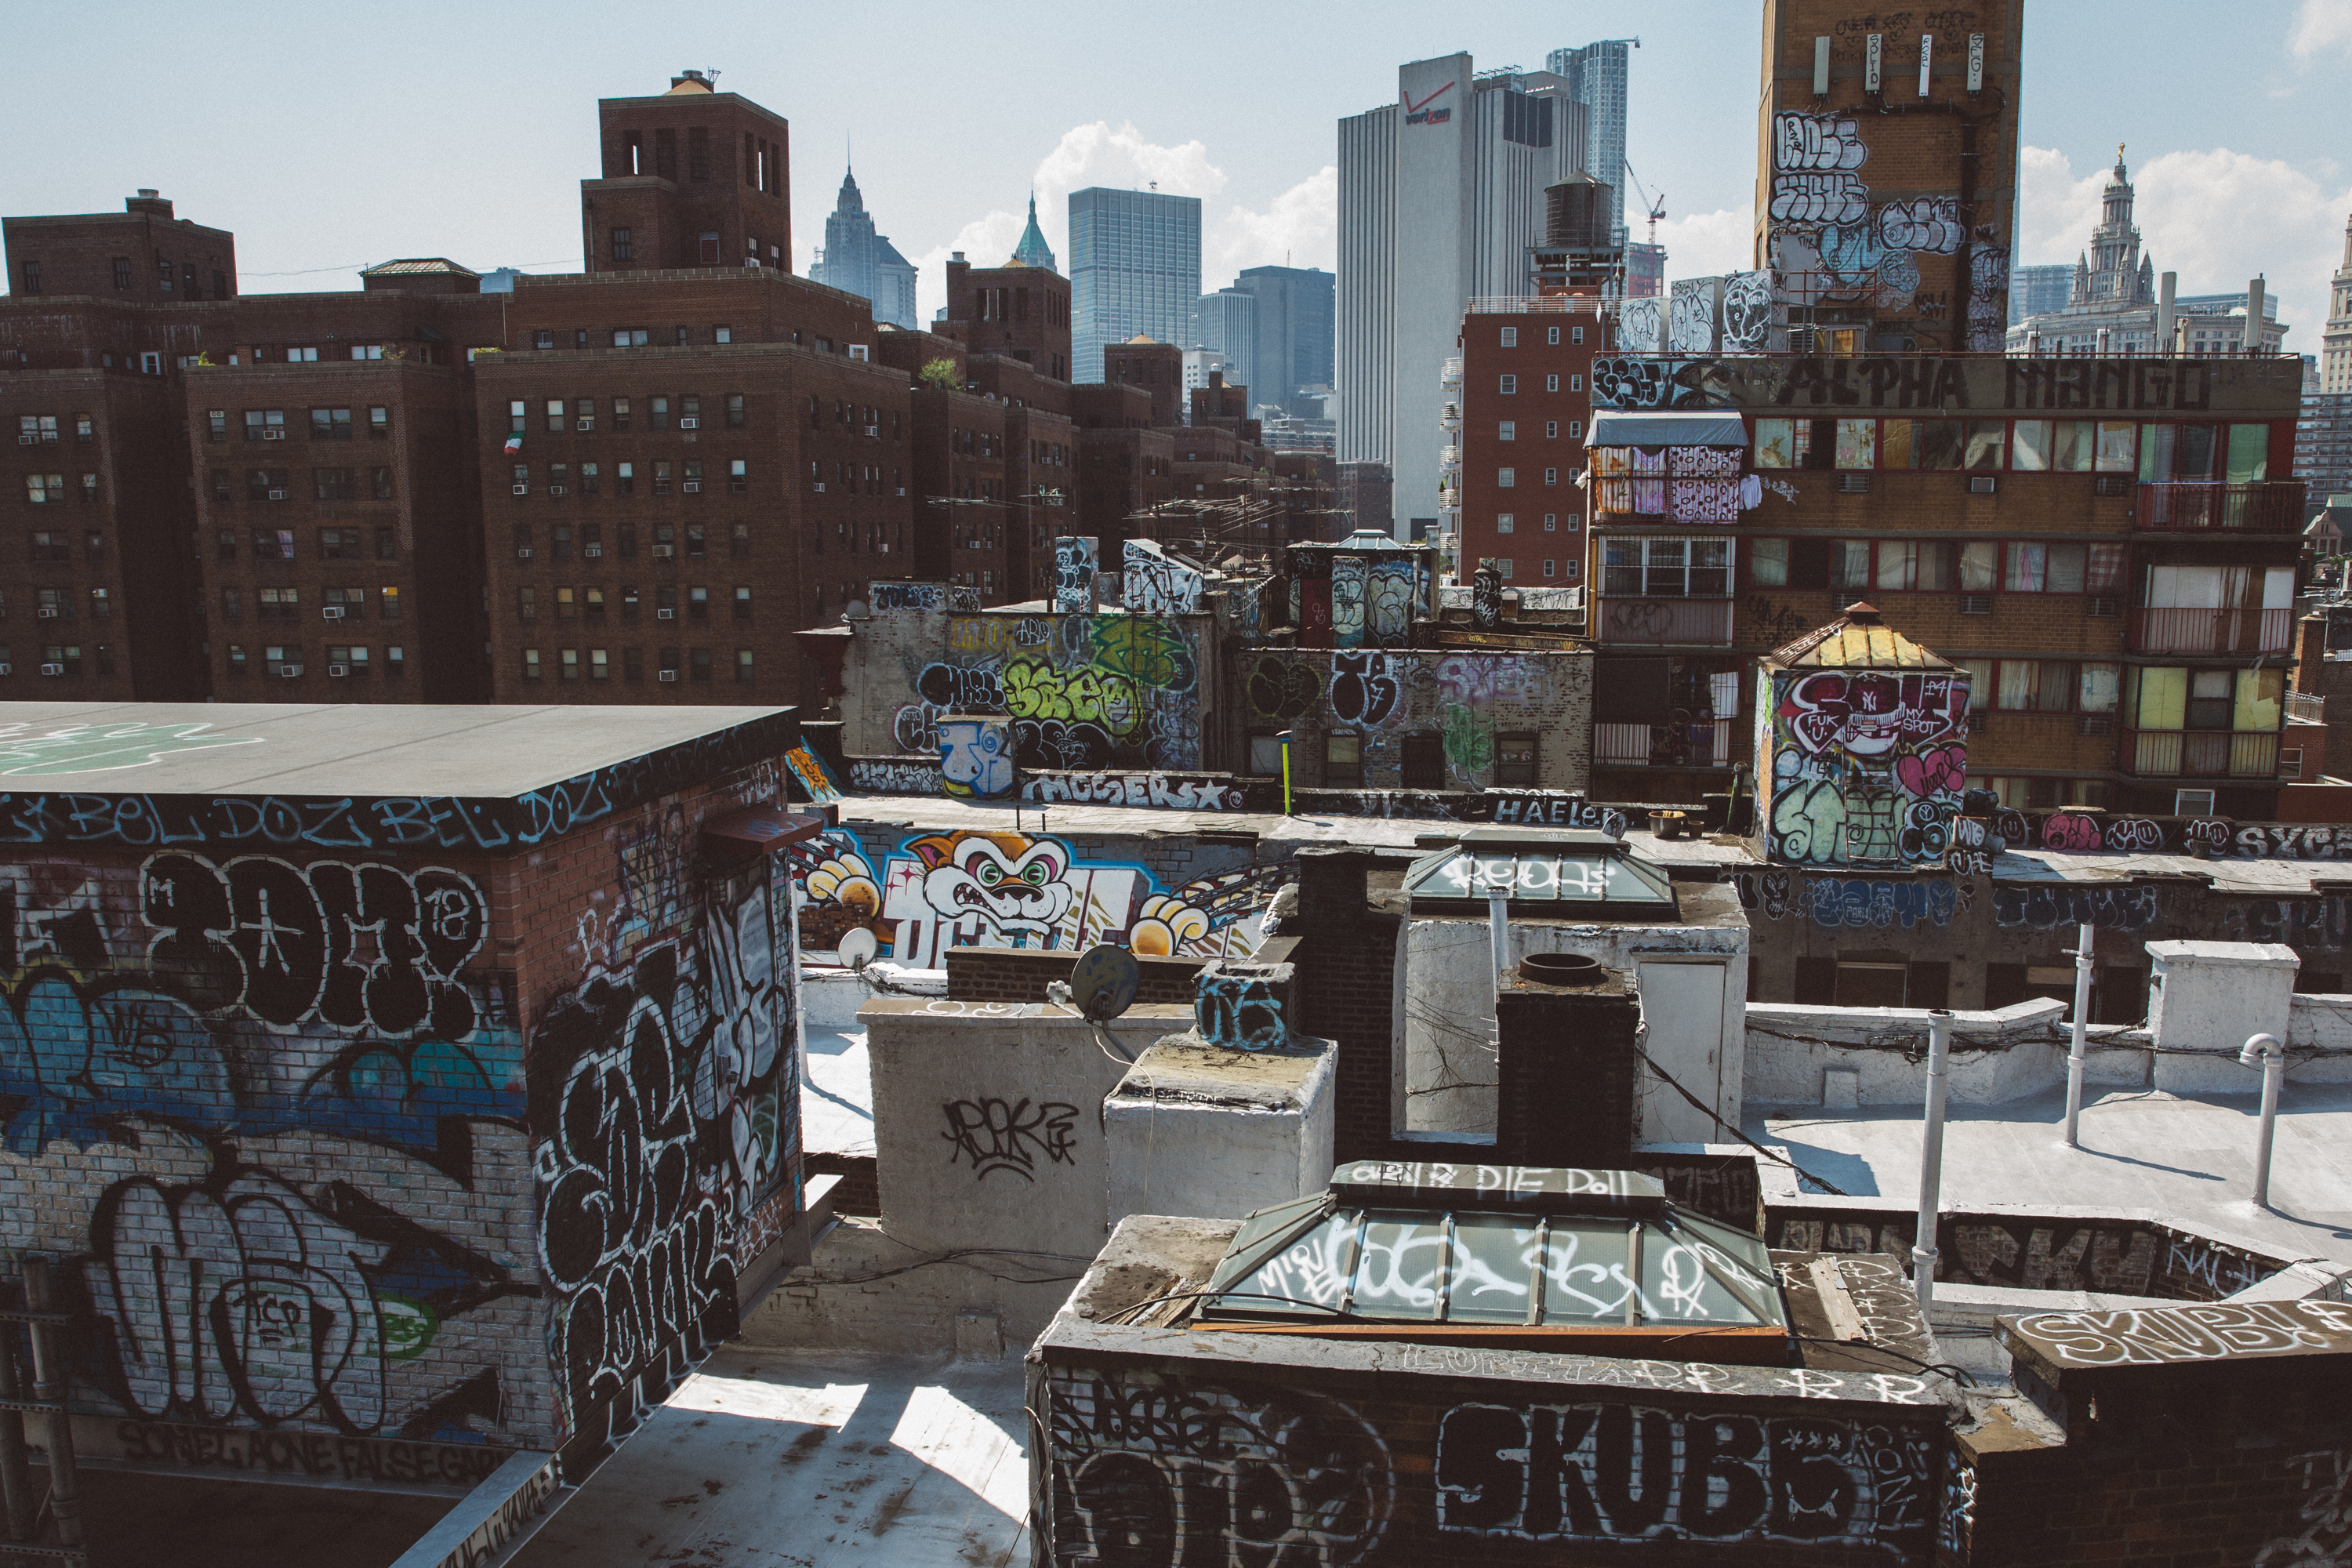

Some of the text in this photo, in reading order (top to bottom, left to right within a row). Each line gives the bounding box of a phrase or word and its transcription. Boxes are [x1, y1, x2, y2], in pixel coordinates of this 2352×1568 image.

[1406, 107, 1451, 125] verizon
[1775, 358, 1969, 409] ALPHA
[1808, 714, 1840, 728] FUK
[1903, 718, 1941, 735] SPOT
[1403, 1344, 1638, 1384] LUPITA
